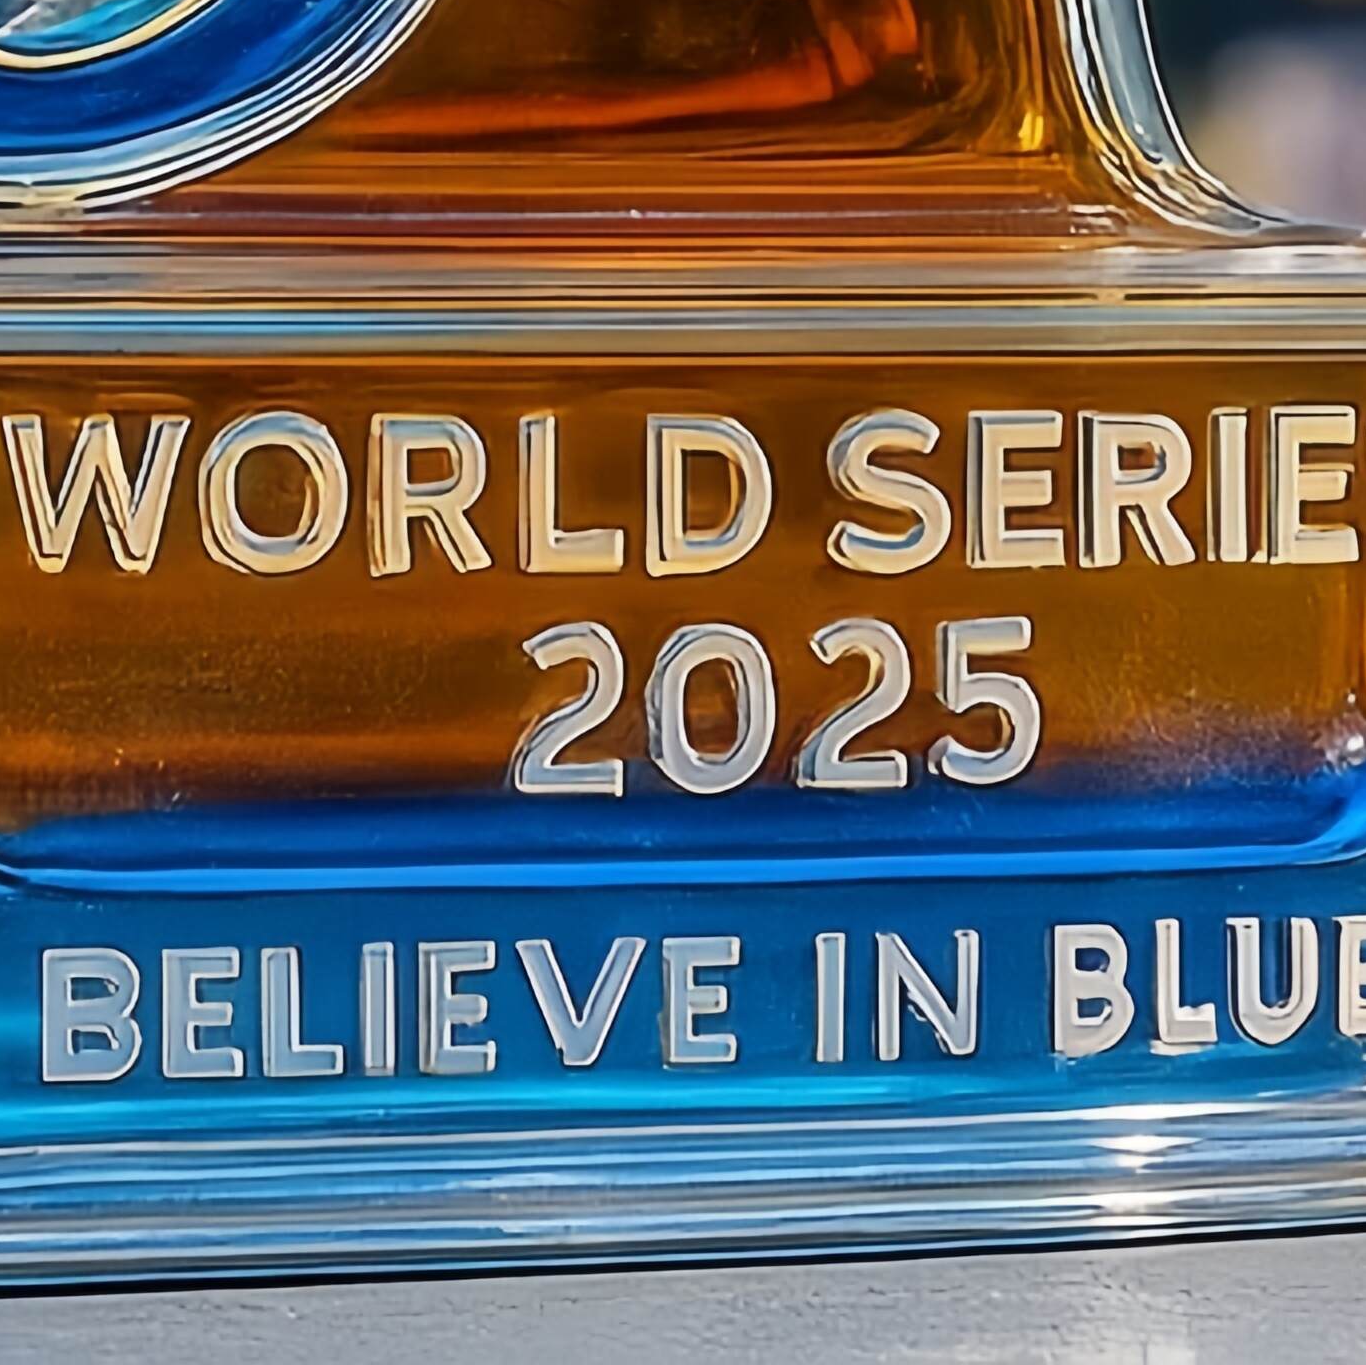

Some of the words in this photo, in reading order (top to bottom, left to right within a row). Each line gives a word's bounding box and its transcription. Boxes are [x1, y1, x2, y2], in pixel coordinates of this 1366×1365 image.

[0, 410, 776, 579] WORLD
[509, 614, 1042, 797] 2025
[37, 933, 743, 1085] BELIEVE
[814, 926, 982, 1065] IN
